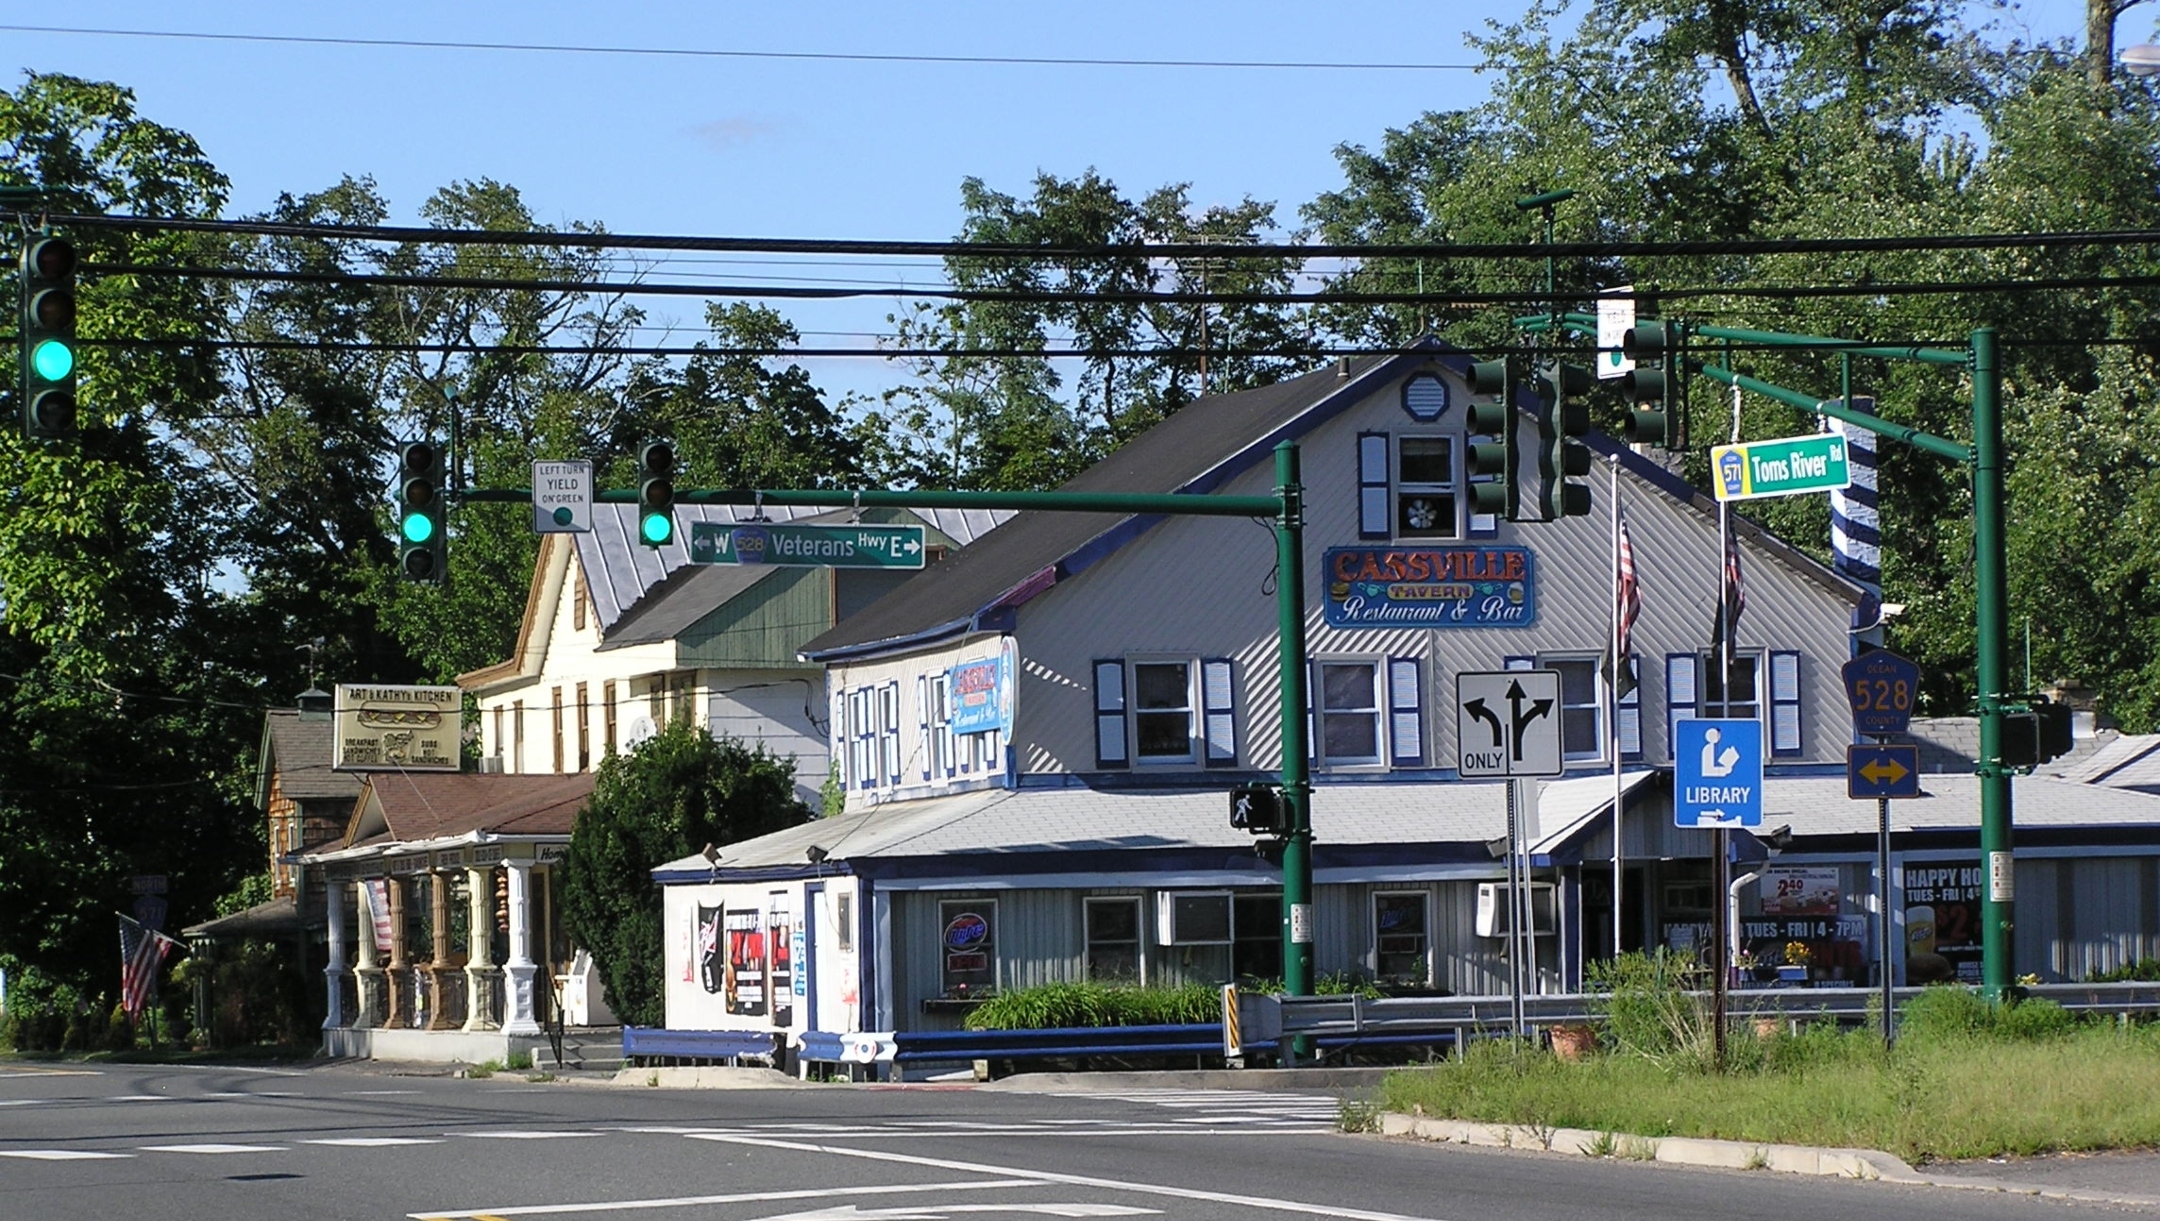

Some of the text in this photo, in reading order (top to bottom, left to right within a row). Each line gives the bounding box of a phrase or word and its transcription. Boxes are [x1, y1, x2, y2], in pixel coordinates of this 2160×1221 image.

[540, 466, 584, 475] LEFT TURN
[1752, 444, 1843, 483] Toms River Rd
[1723, 463, 1742, 483] 571
[548, 479, 578, 490] YIELD
[542, 494, 584, 503] ON GREEN
[713, 533, 902, 557] W 528 Veterans Hwy E
[1334, 552, 1525, 582] CASSVILLE
[1392, 586, 1471, 598] TAVERN
[1336, 595, 1524, 622] Restaurant & Bar
[1867, 665, 1897, 674] OCEAN
[349, 688, 366, 699] ART
[414, 691, 452, 701] KITCHEN
[1855, 680, 1908, 711] 528
[1865, 716, 1900, 725] COUNTY
[421, 740, 438, 748] SUBS
[411, 756, 449, 765] SANDWICHES
[1464, 752, 1503, 769] ONLY
[1686, 787, 1750, 804] LIBRARY
[1906, 868, 1958, 888] HAPPY
[1961, 867, 1983, 886] HO
[1908, 889, 1934, 902] TUES
[1943, 888, 1959, 901] FRI
[1746, 922, 1777, 937] TUES
[1788, 922, 1807, 937] FRI
[1817, 922, 1826, 936] 4
[1836, 921, 1862, 936] 7PM
